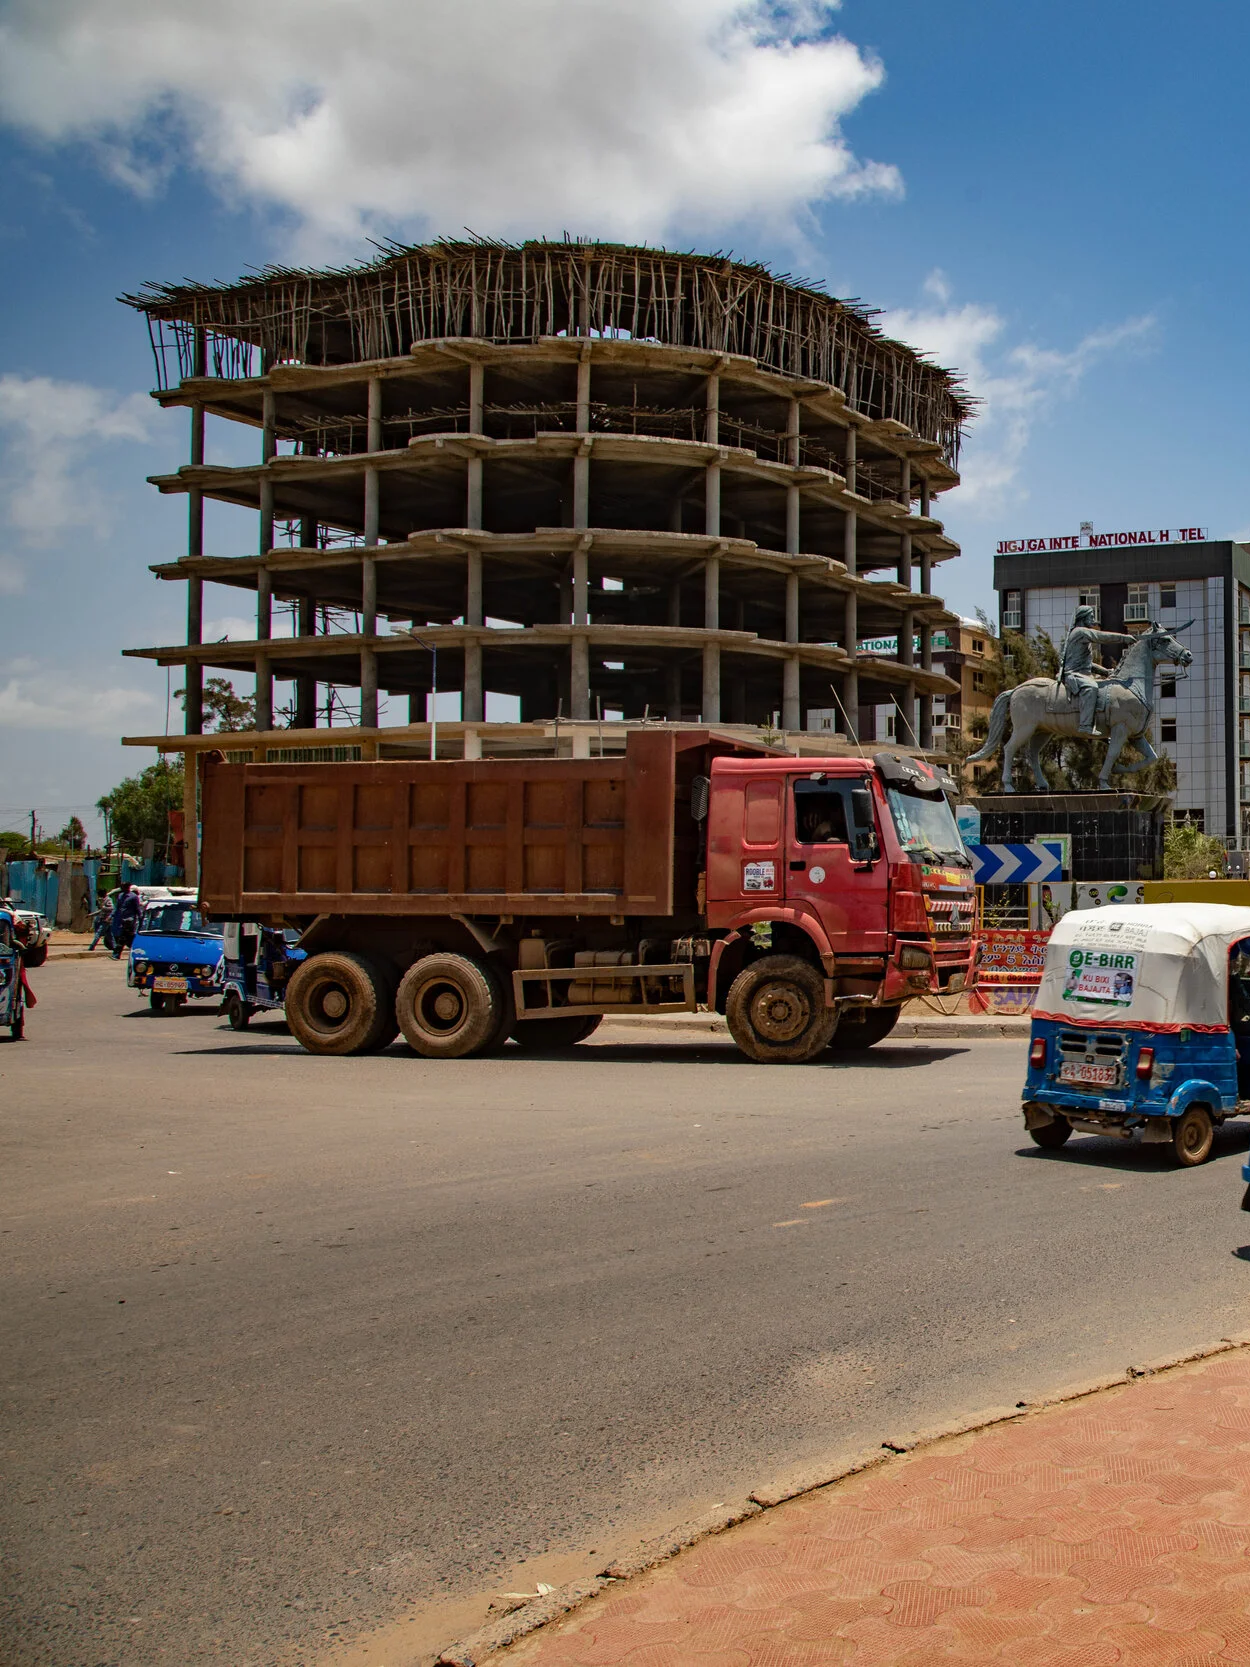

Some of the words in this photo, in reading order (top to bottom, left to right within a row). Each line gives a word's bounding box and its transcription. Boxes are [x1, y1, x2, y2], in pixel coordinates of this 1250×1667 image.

[1084, 952, 1134, 969] E-BIRR
[1083, 974, 1093, 982] KU
[1095, 975, 1110, 984] BIXI
[1078, 984, 1111, 994] BAJAJTA
